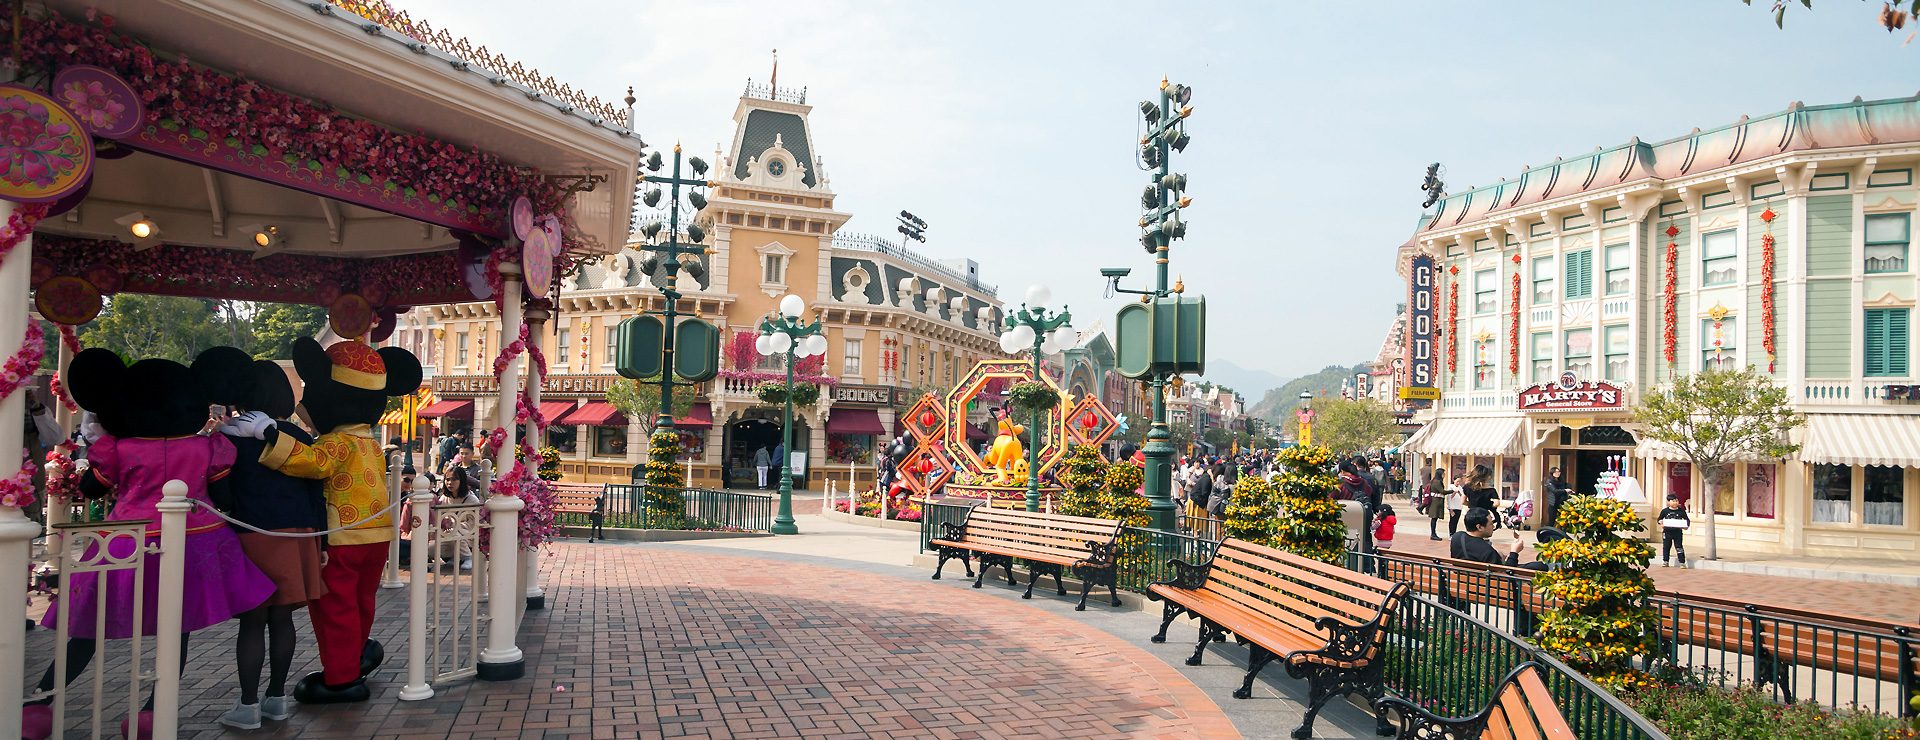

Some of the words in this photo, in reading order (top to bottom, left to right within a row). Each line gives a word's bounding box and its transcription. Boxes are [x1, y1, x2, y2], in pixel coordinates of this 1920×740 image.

[1416, 266, 1430, 384] GOODS
[436, 379, 524, 392] DISNEYLD
[836, 388, 888, 402] BOOKS
